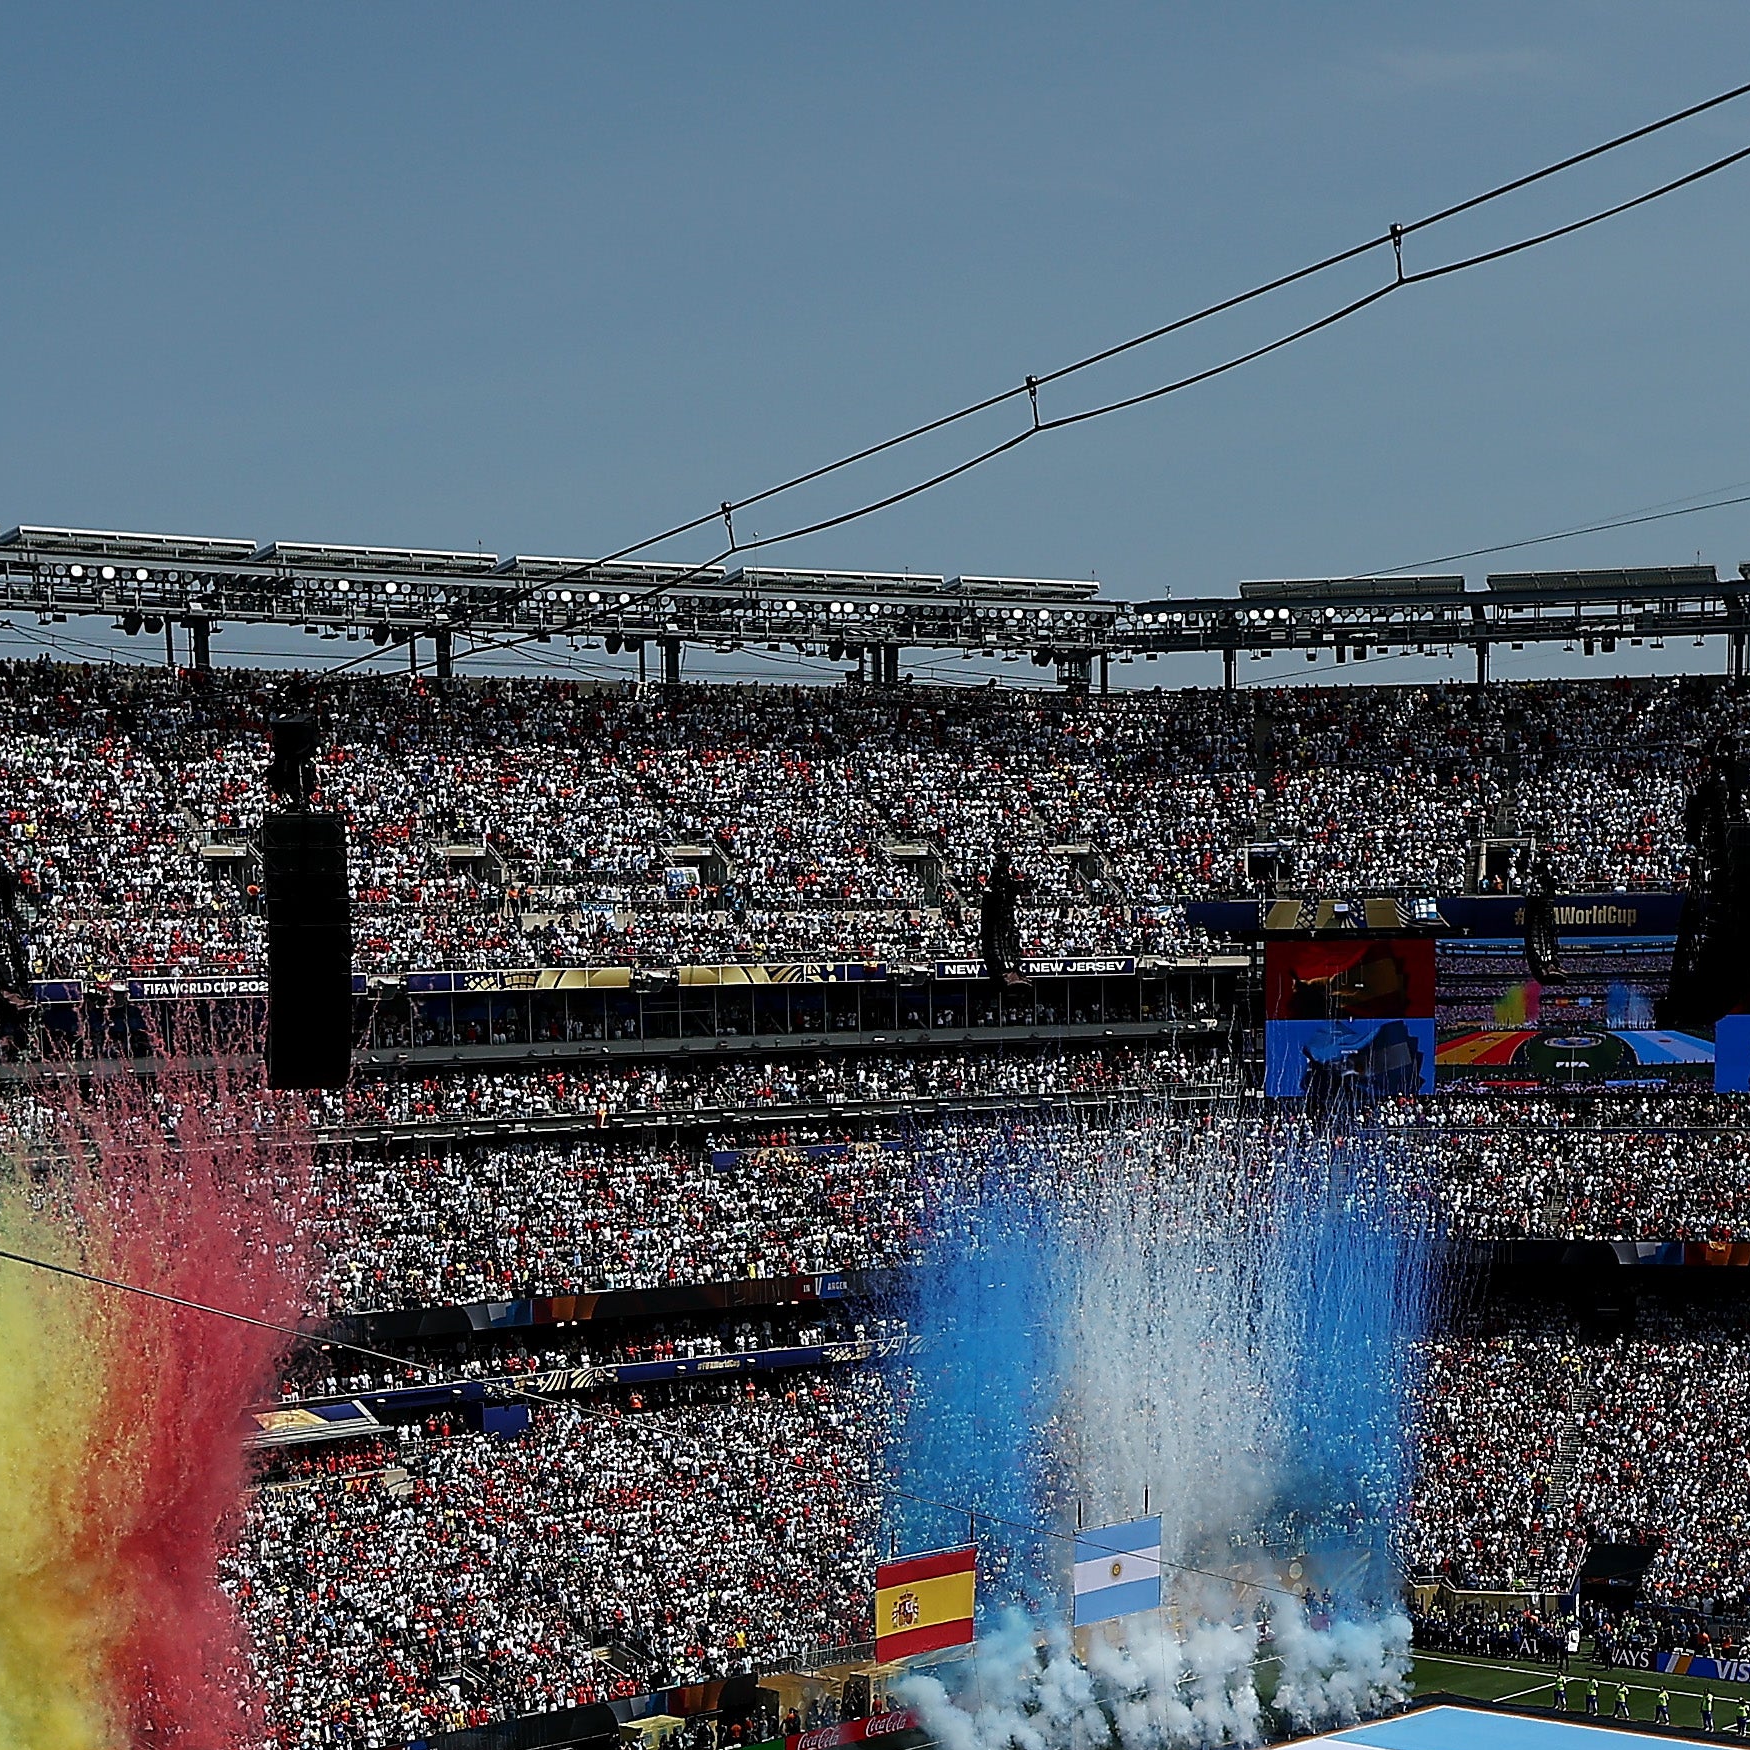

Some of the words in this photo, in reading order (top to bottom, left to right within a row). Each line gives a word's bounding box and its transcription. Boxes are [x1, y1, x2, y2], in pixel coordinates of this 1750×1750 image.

[1514, 905, 1637, 927] #AWorldCup
[944, 963, 981, 976] NEW
[1029, 962, 1064, 974] NEW
[1066, 960, 1126, 973] JERSEY
[143, 982, 169, 996] FIFA
[169, 981, 212, 995] WORLD
[213, 980, 237, 994] CUP
[238, 980, 269, 993] 202
[1555, 1060, 1589, 1069] FIFA
